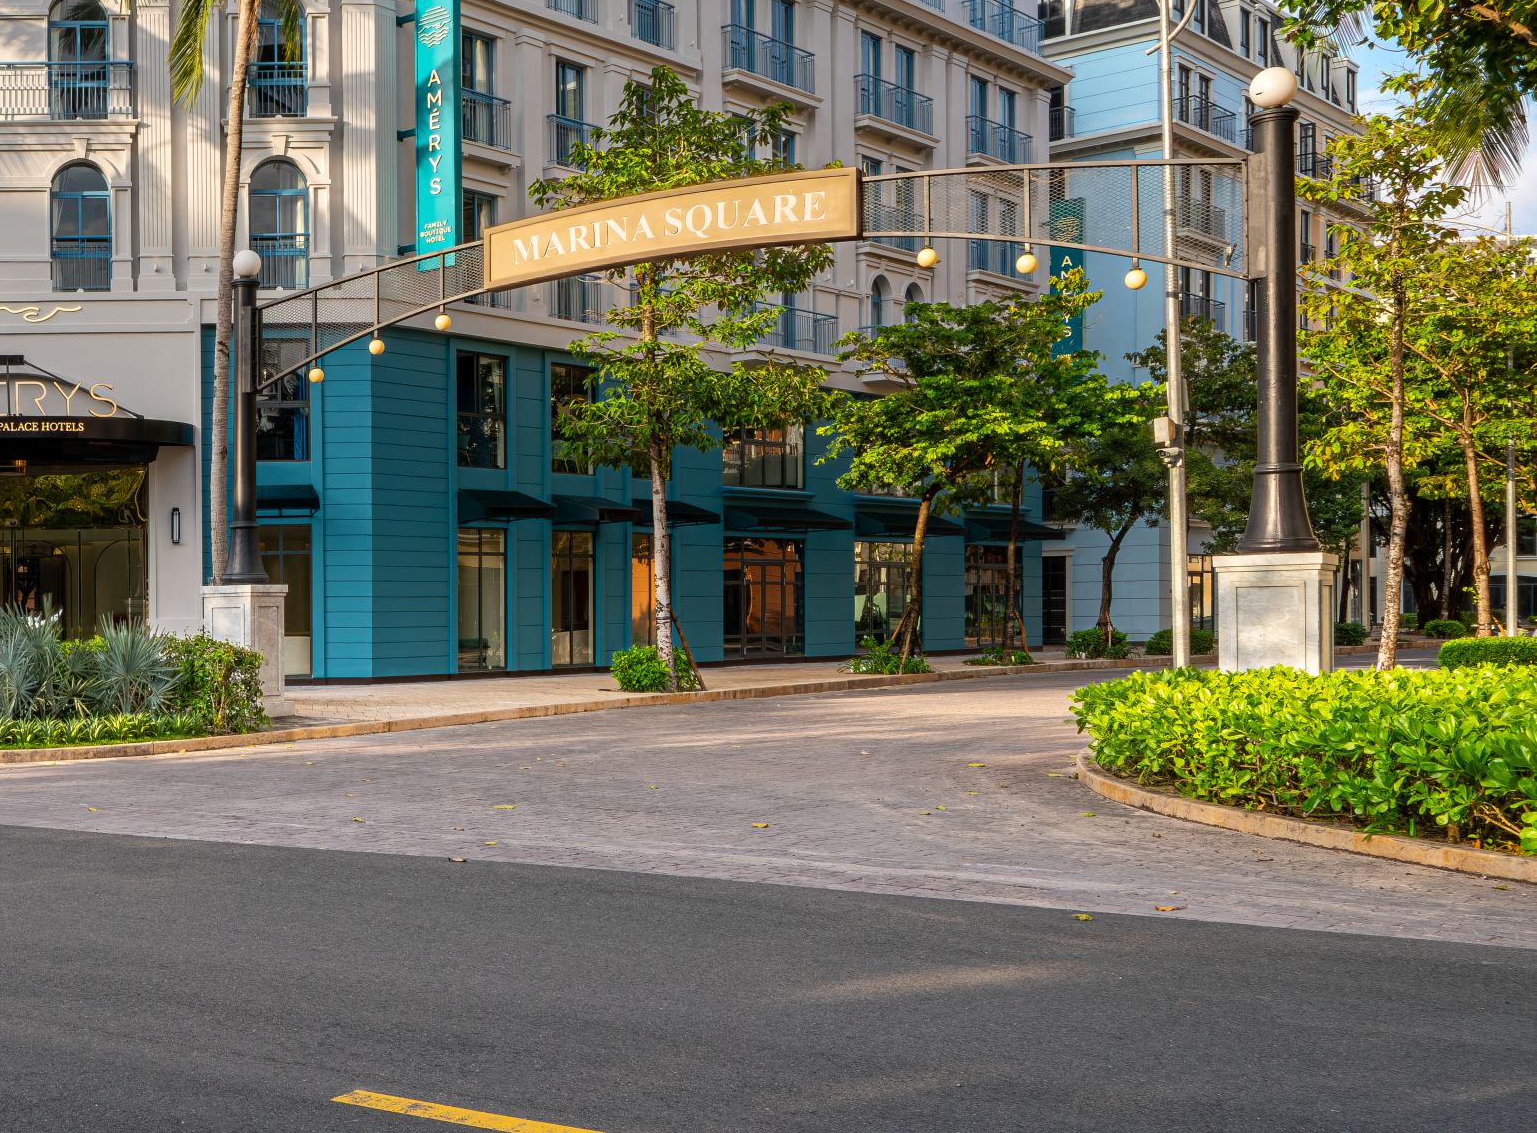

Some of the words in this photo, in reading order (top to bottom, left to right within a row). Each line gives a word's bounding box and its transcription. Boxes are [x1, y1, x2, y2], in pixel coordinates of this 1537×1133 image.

[426, 69, 442, 195] AMÉRYS
[425, 219, 448, 229] FAMILY
[512, 214, 655, 265] MARINA
[662, 190, 827, 238] SQUARE
[420, 227, 452, 238] BOUTIQUE
[426, 235, 446, 244] HOTEL
[41, 422, 85, 432] HOTELS
